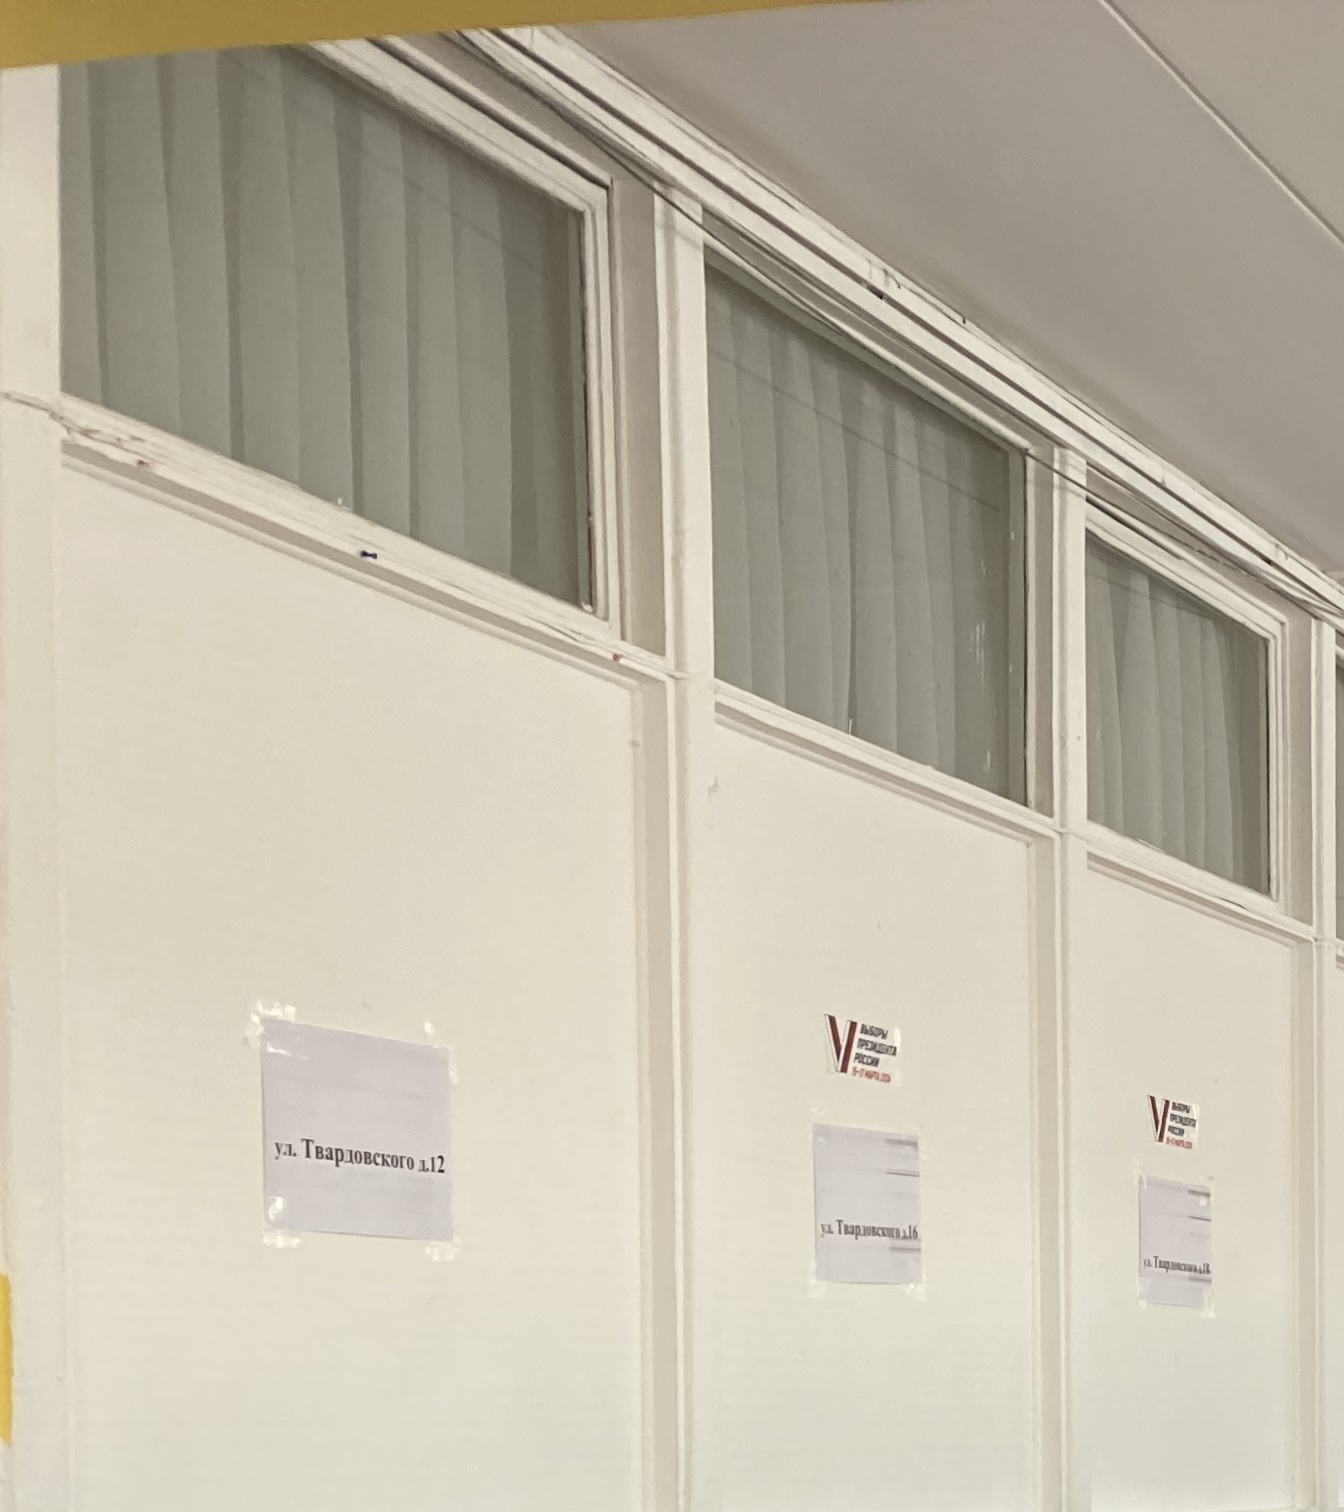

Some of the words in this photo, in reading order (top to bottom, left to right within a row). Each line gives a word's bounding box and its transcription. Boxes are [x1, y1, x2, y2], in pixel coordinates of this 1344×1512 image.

[274, 1141, 297, 1160] ул.
[300, 1138, 415, 1170] Твардовского
[418, 1154, 446, 1174] д.12
[835, 1218, 901, 1240] Твардовского
